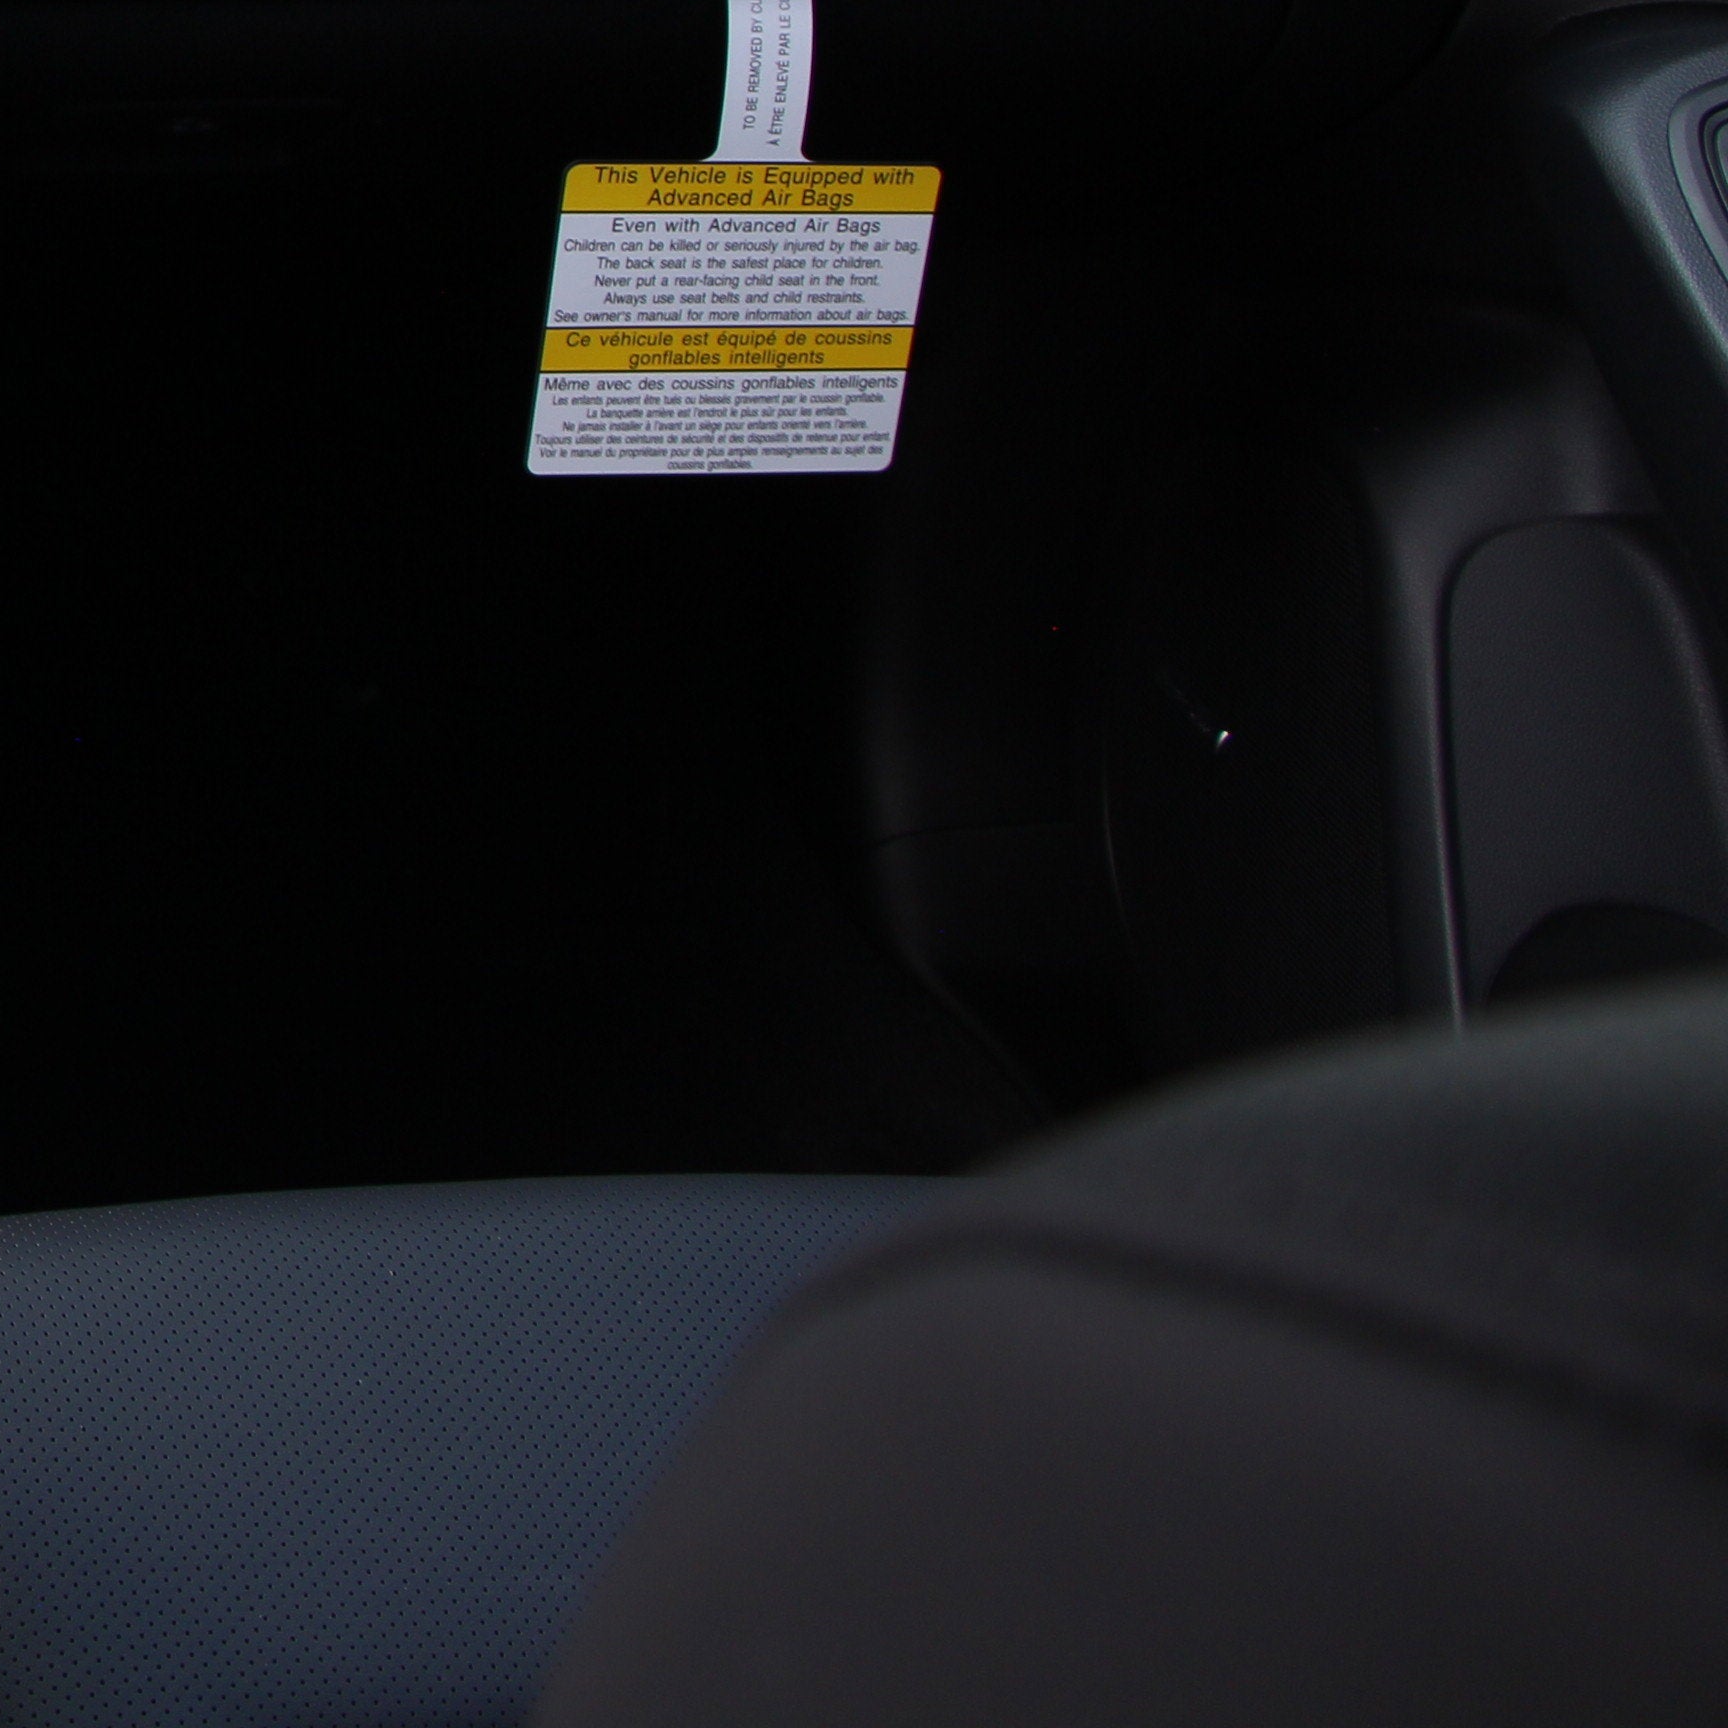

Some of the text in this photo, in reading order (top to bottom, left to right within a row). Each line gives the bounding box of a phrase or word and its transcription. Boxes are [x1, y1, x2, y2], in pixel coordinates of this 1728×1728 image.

[750, 17, 763, 33] BY
[778, 16, 790, 29] LE
[778, 33, 790, 56] PAR
[748, 37, 762, 93] REMOVED
[745, 98, 758, 111] BE
[742, 115, 755, 130] TO
[595, 166, 914, 188] This Vehicle is Equipped with
[646, 188, 854, 211] Advanced Air Bags
[611, 217, 881, 236] Even with Advanced Air Bags
[563, 238, 921, 254] Children can be killed or seriously injured by the air bag.
[597, 256, 883, 271] The back seat is the safest place for children.
[594, 273, 879, 289] Never put a rear-facing child seat in the front.
[603, 291, 865, 306] Always use seat belts and child restraints.
[554, 308, 910, 323] See owner's manual for more information about air bags.
[566, 330, 892, 349] Ce véhicule est équipé de coussins
[629, 350, 824, 370] gonflables intelligents
[544, 375, 898, 392] Même avec des coussins gonflables intelligents
